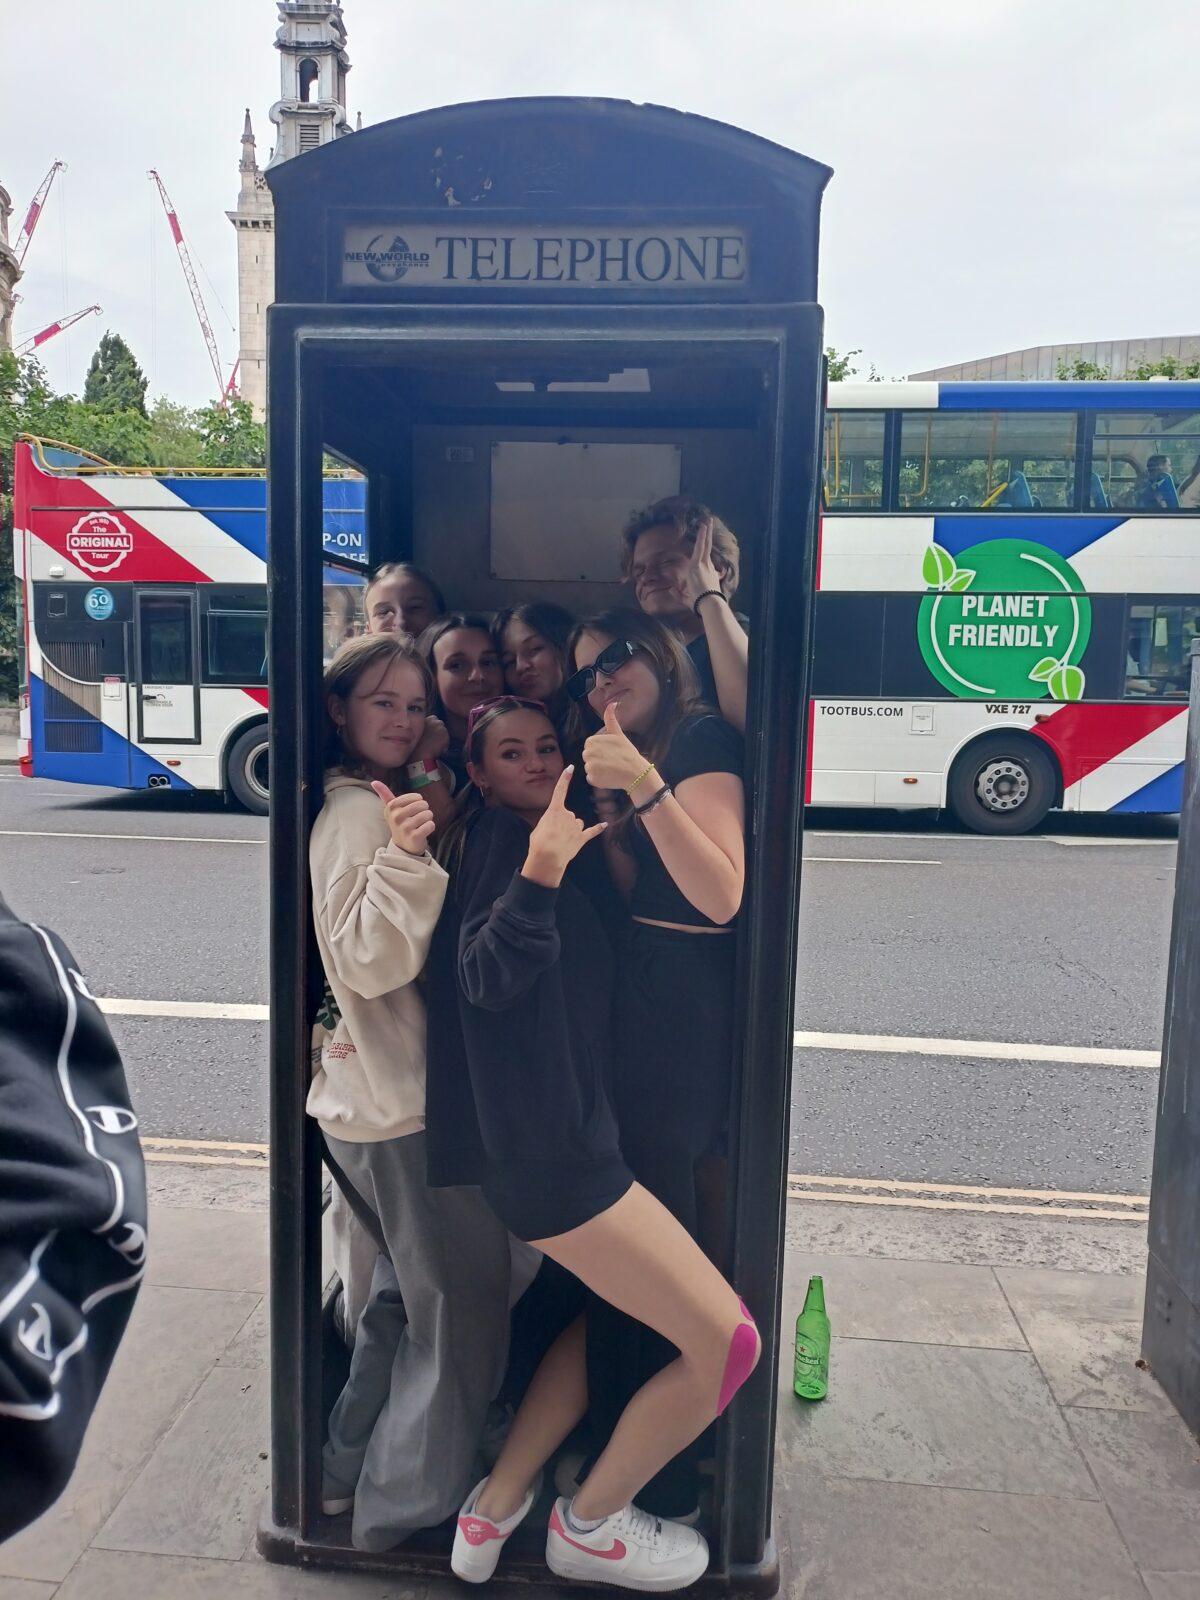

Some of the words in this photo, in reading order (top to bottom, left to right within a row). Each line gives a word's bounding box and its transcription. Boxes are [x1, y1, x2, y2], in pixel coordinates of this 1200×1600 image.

[344, 252, 376, 261] NEW
[380, 252, 430, 261] WORLD
[435, 236, 746, 282] TELEPHONE
[962, 595, 1050, 618] PLANET
[948, 624, 1060, 647] FRIENDLY
[820, 706, 904, 717] TOOTBUS.COM
[985, 704, 1008, 714] VXE
[1011, 705, 1032, 714] 727
